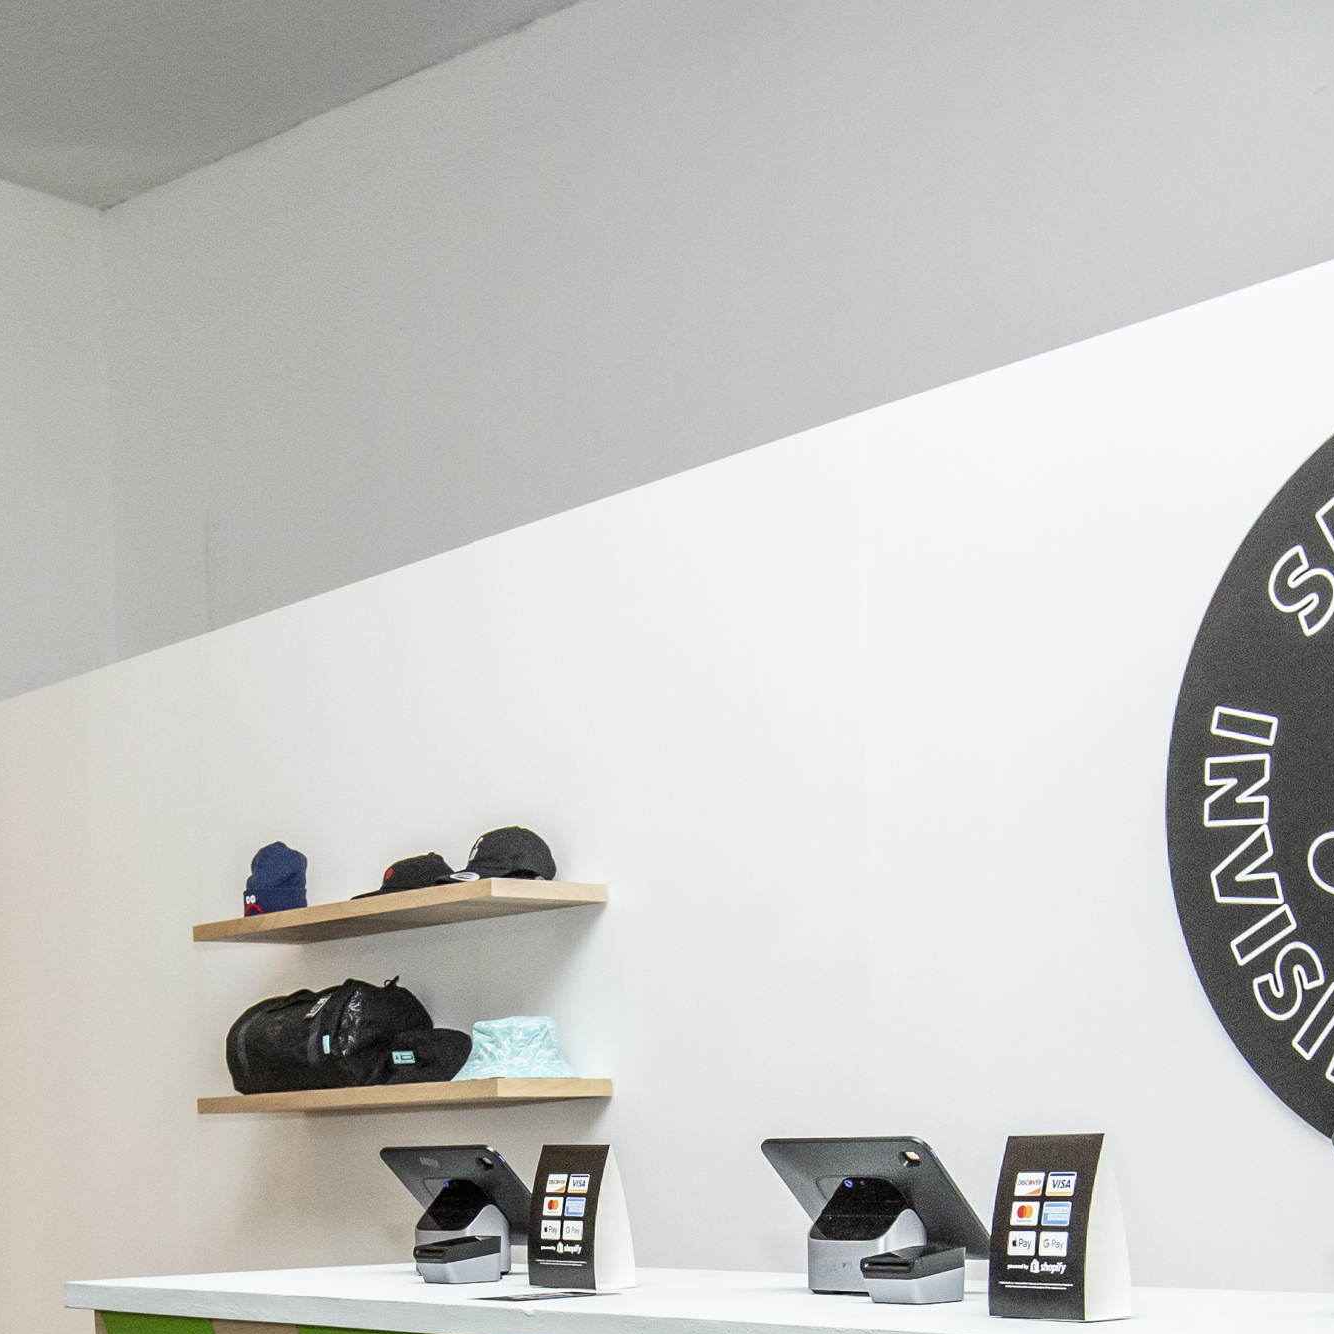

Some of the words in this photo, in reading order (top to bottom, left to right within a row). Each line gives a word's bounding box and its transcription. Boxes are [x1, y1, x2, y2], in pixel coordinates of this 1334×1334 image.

[572, 1180, 586, 1188] VISA
[1052, 1179, 1071, 1189] VISA
[1018, 1238, 1032, 1250] Pay
[1051, 1239, 1064, 1251] Pay
[1040, 1261, 1067, 1275] shopify
